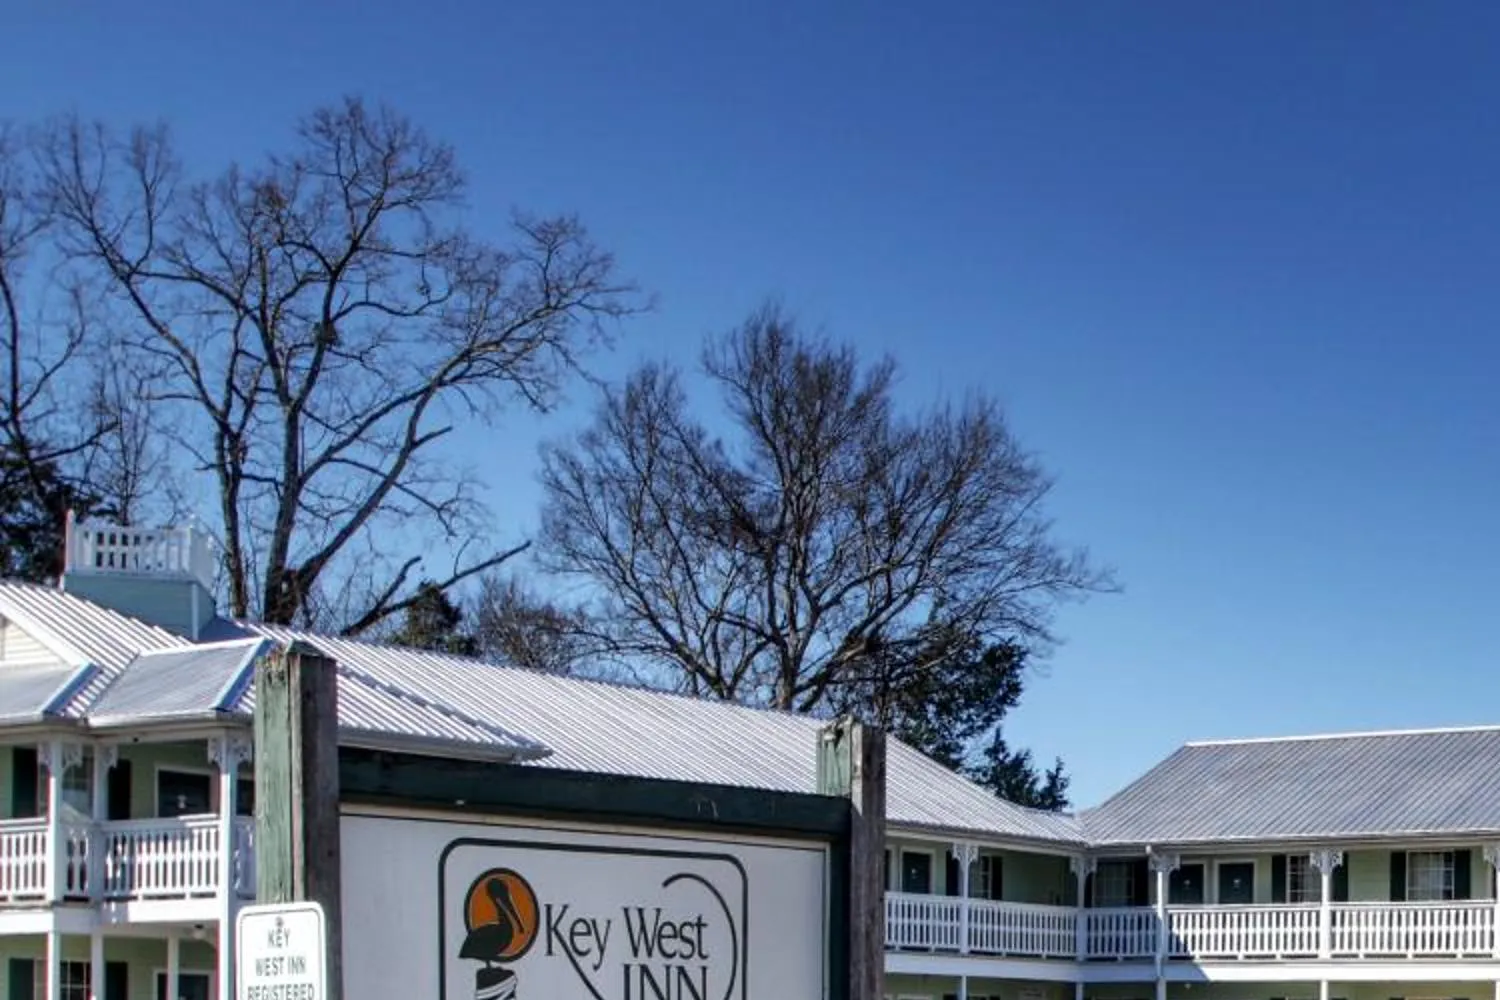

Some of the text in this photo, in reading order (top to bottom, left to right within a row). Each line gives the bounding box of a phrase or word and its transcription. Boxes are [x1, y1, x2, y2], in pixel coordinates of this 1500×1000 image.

[267, 928, 291, 948] KEY
[544, 903, 710, 971] Key West
[256, 956, 307, 976] WEST INN
